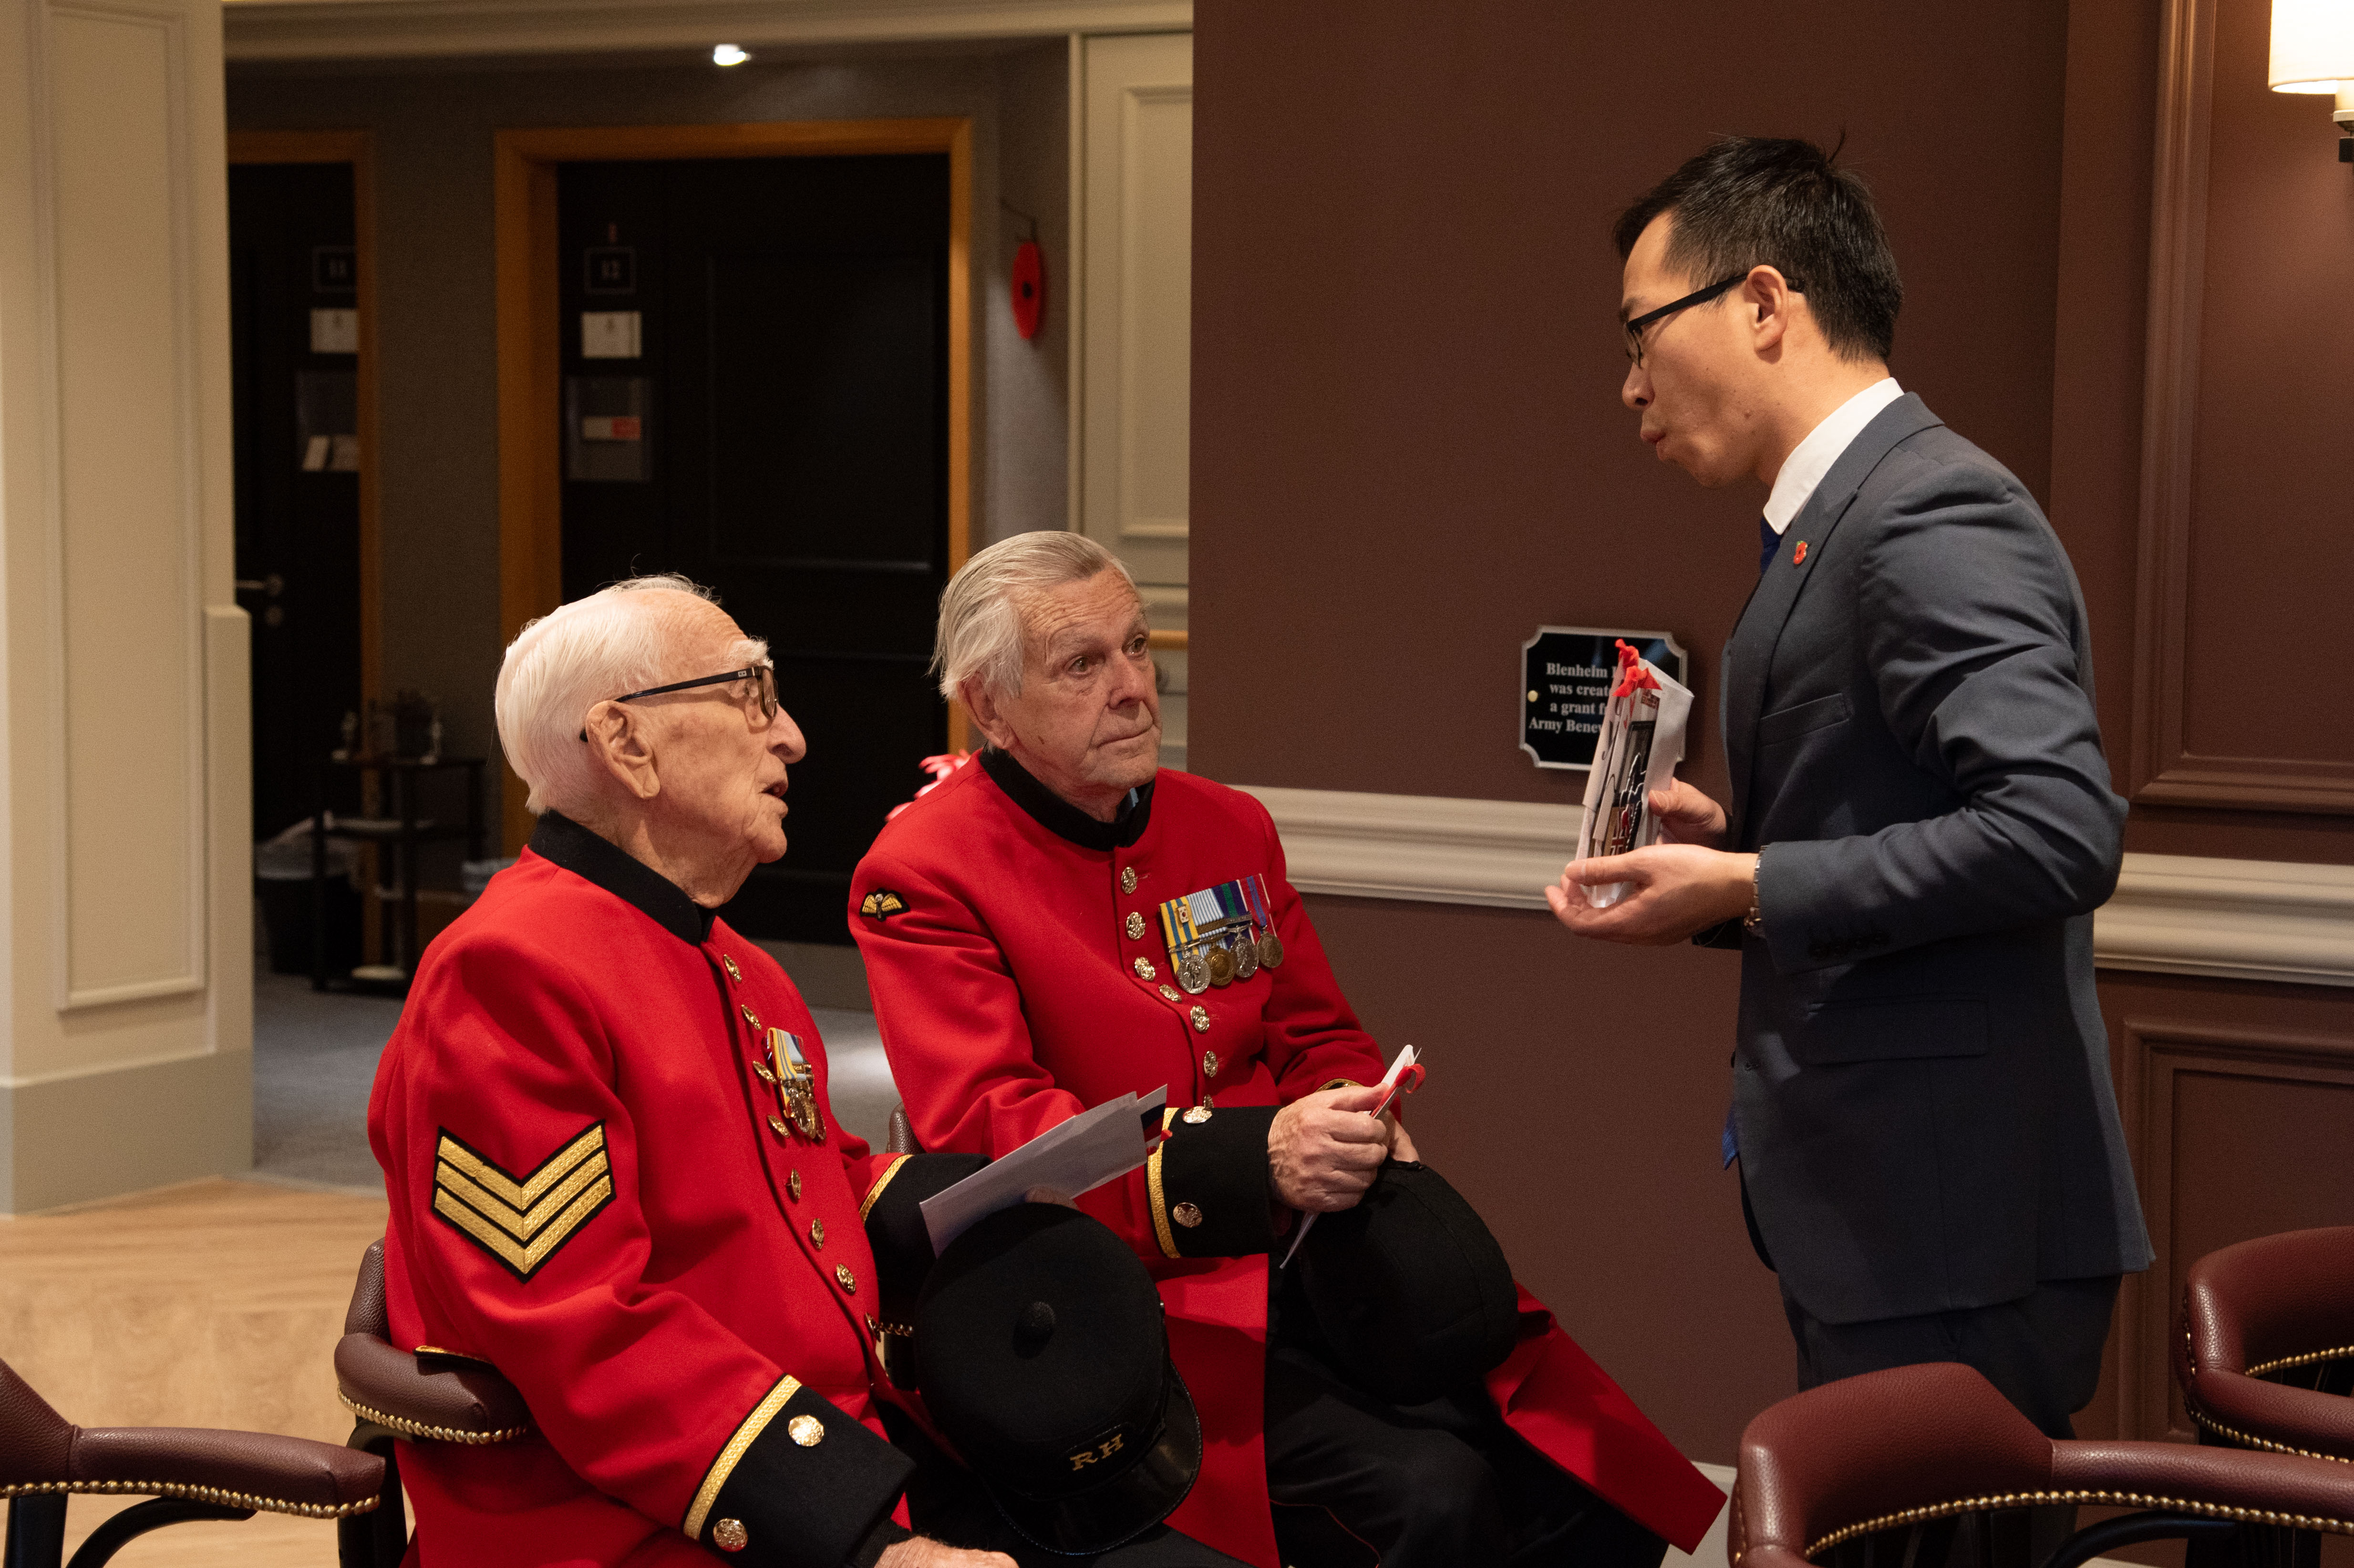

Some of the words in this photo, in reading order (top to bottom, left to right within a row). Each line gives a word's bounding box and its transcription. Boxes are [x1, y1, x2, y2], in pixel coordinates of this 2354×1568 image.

[1546, 662, 1608, 678] Blenheim
[1550, 684, 1573, 695] was
[1576, 685, 1610, 696] creat
[1550, 702, 1558, 712] a
[1561, 702, 1595, 716] grant
[1529, 716, 1562, 734] Army
[1069, 1434, 1124, 1471] RH
